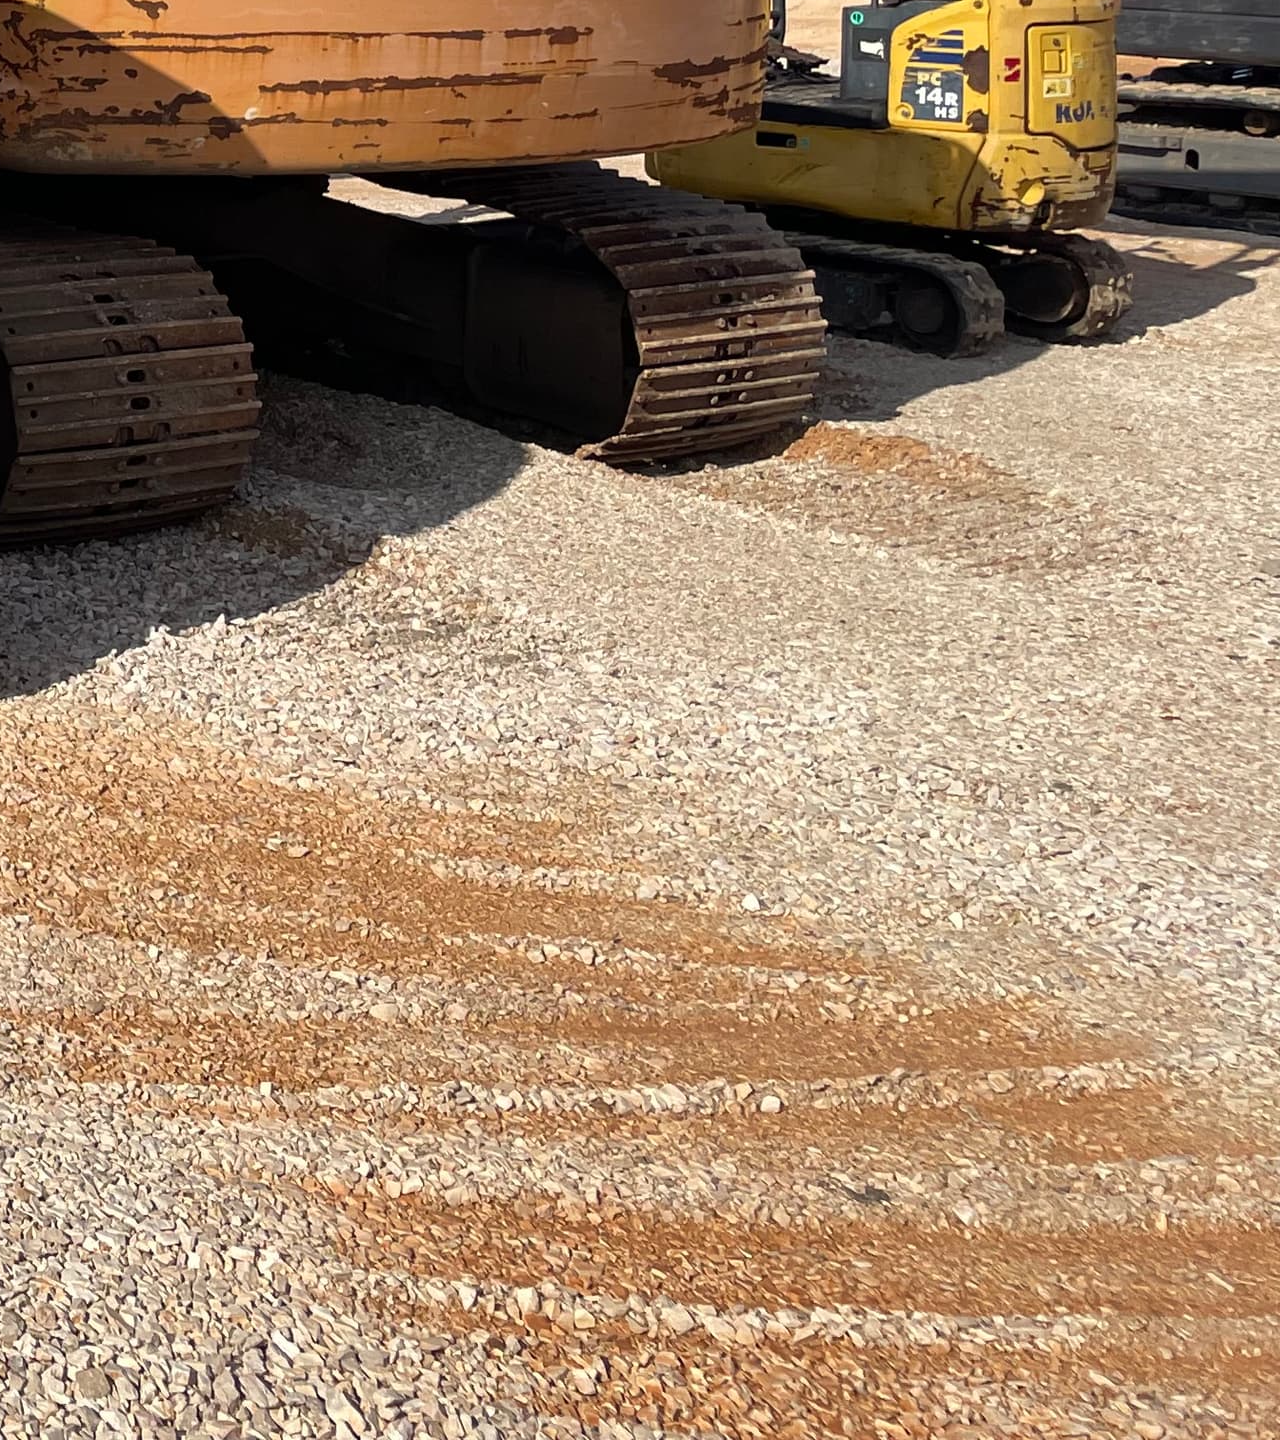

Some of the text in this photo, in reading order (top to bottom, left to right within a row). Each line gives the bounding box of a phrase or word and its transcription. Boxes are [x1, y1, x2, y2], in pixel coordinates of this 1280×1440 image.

[916, 71, 942, 86] PC
[915, 86, 959, 106] 14R
[934, 106, 959, 119] HS
